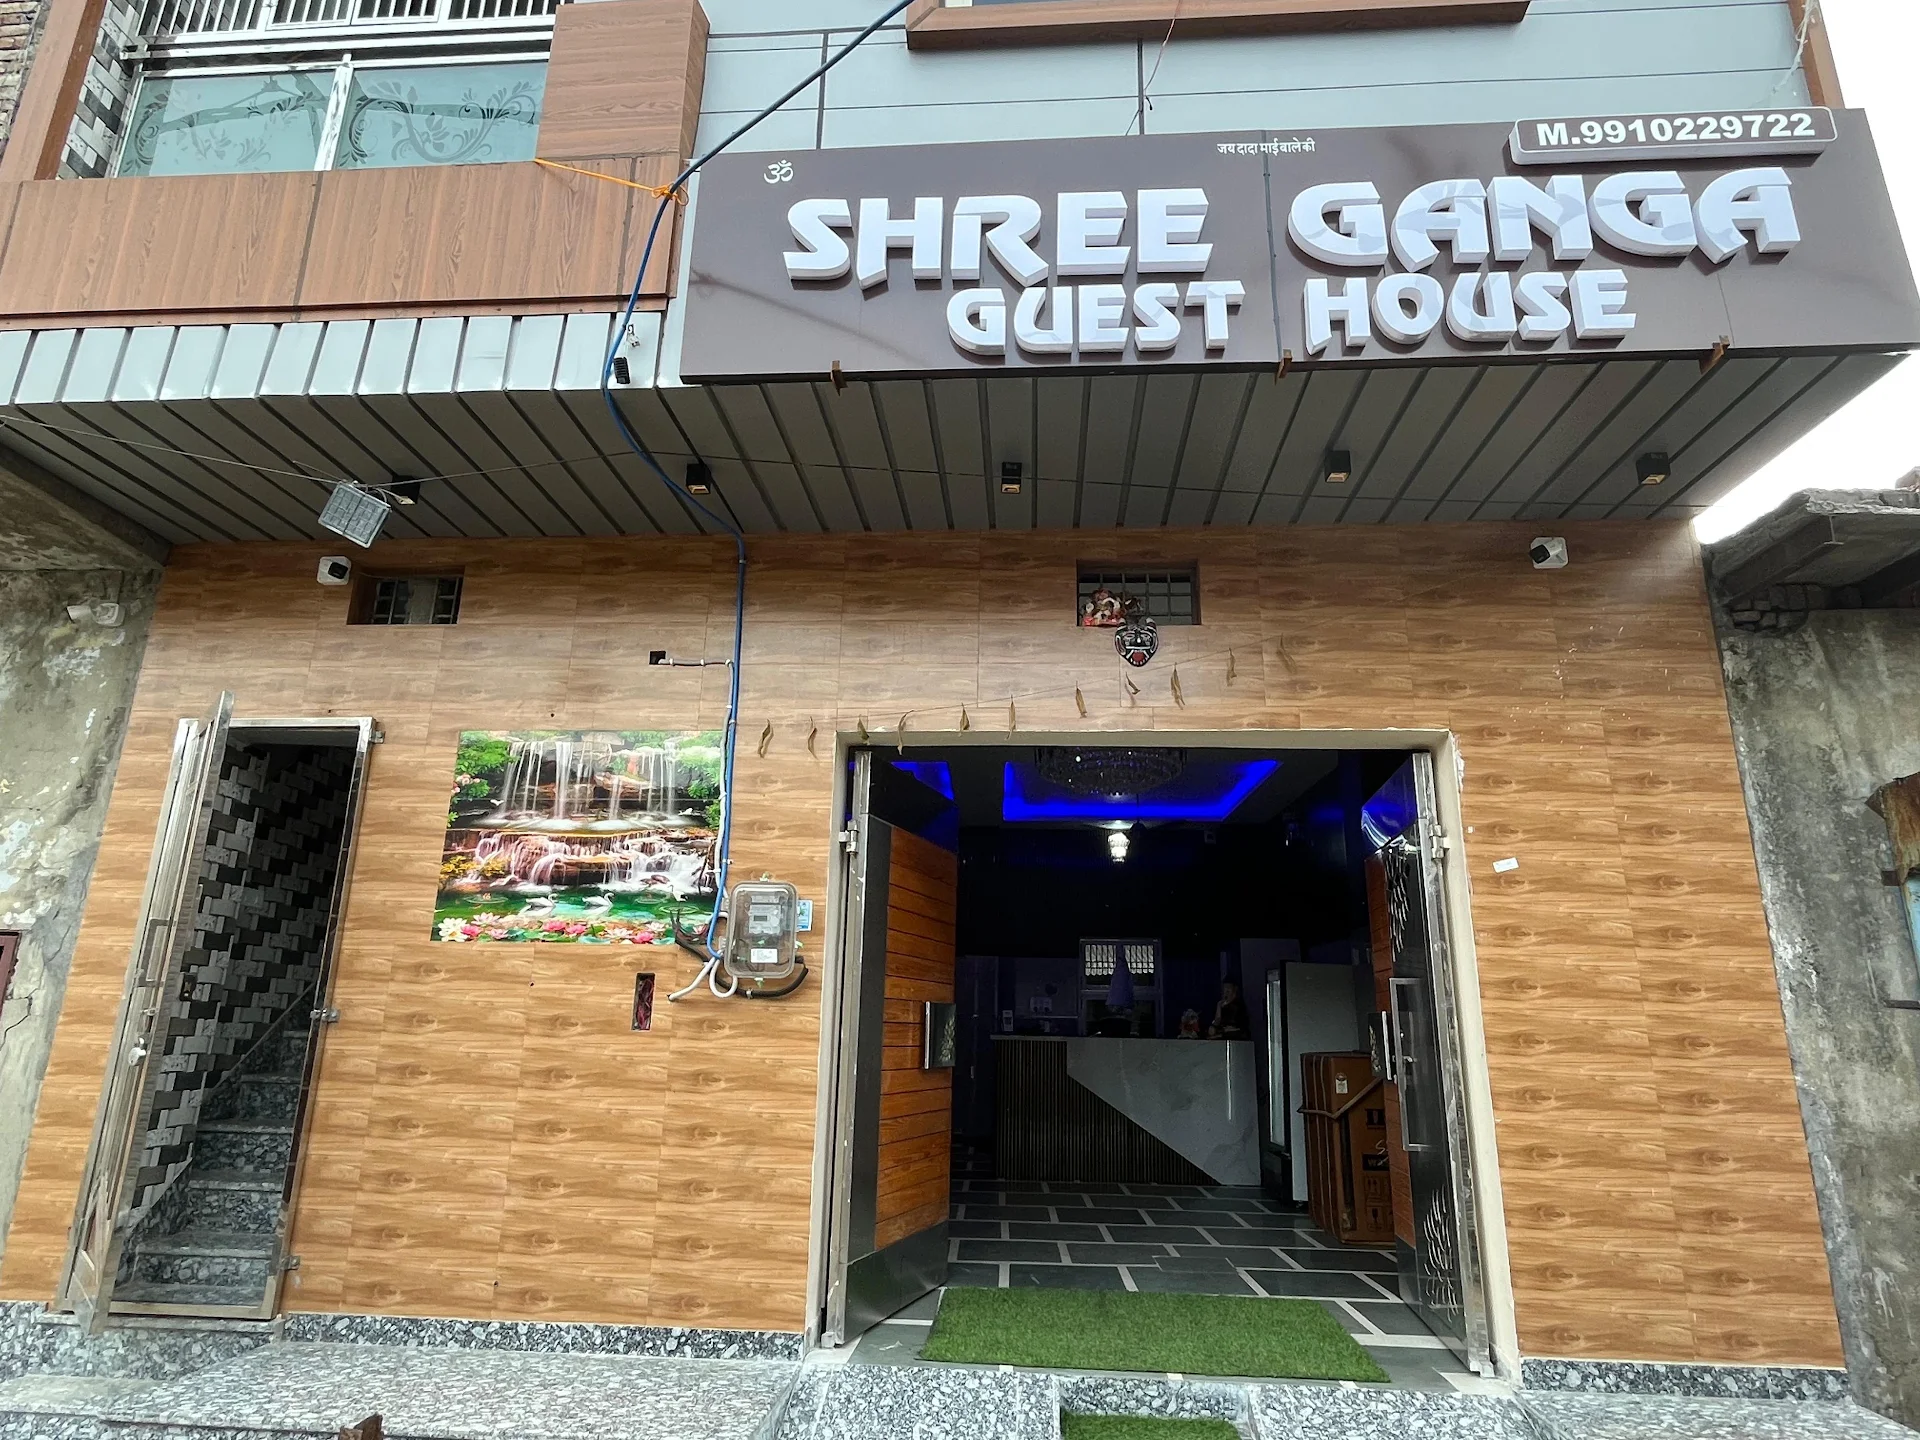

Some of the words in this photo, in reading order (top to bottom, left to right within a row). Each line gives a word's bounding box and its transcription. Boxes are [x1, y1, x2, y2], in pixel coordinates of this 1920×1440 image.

[1217, 143, 1236, 154] जय
[1236, 142, 1259, 156] दादा
[1536, 113, 1816, 146] M.9910229722
[783, 188, 1214, 290] SHREE
[1287, 166, 1801, 272] GANGA
[946, 279, 1246, 357] GUEST
[1303, 269, 1637, 355] HOUSE
